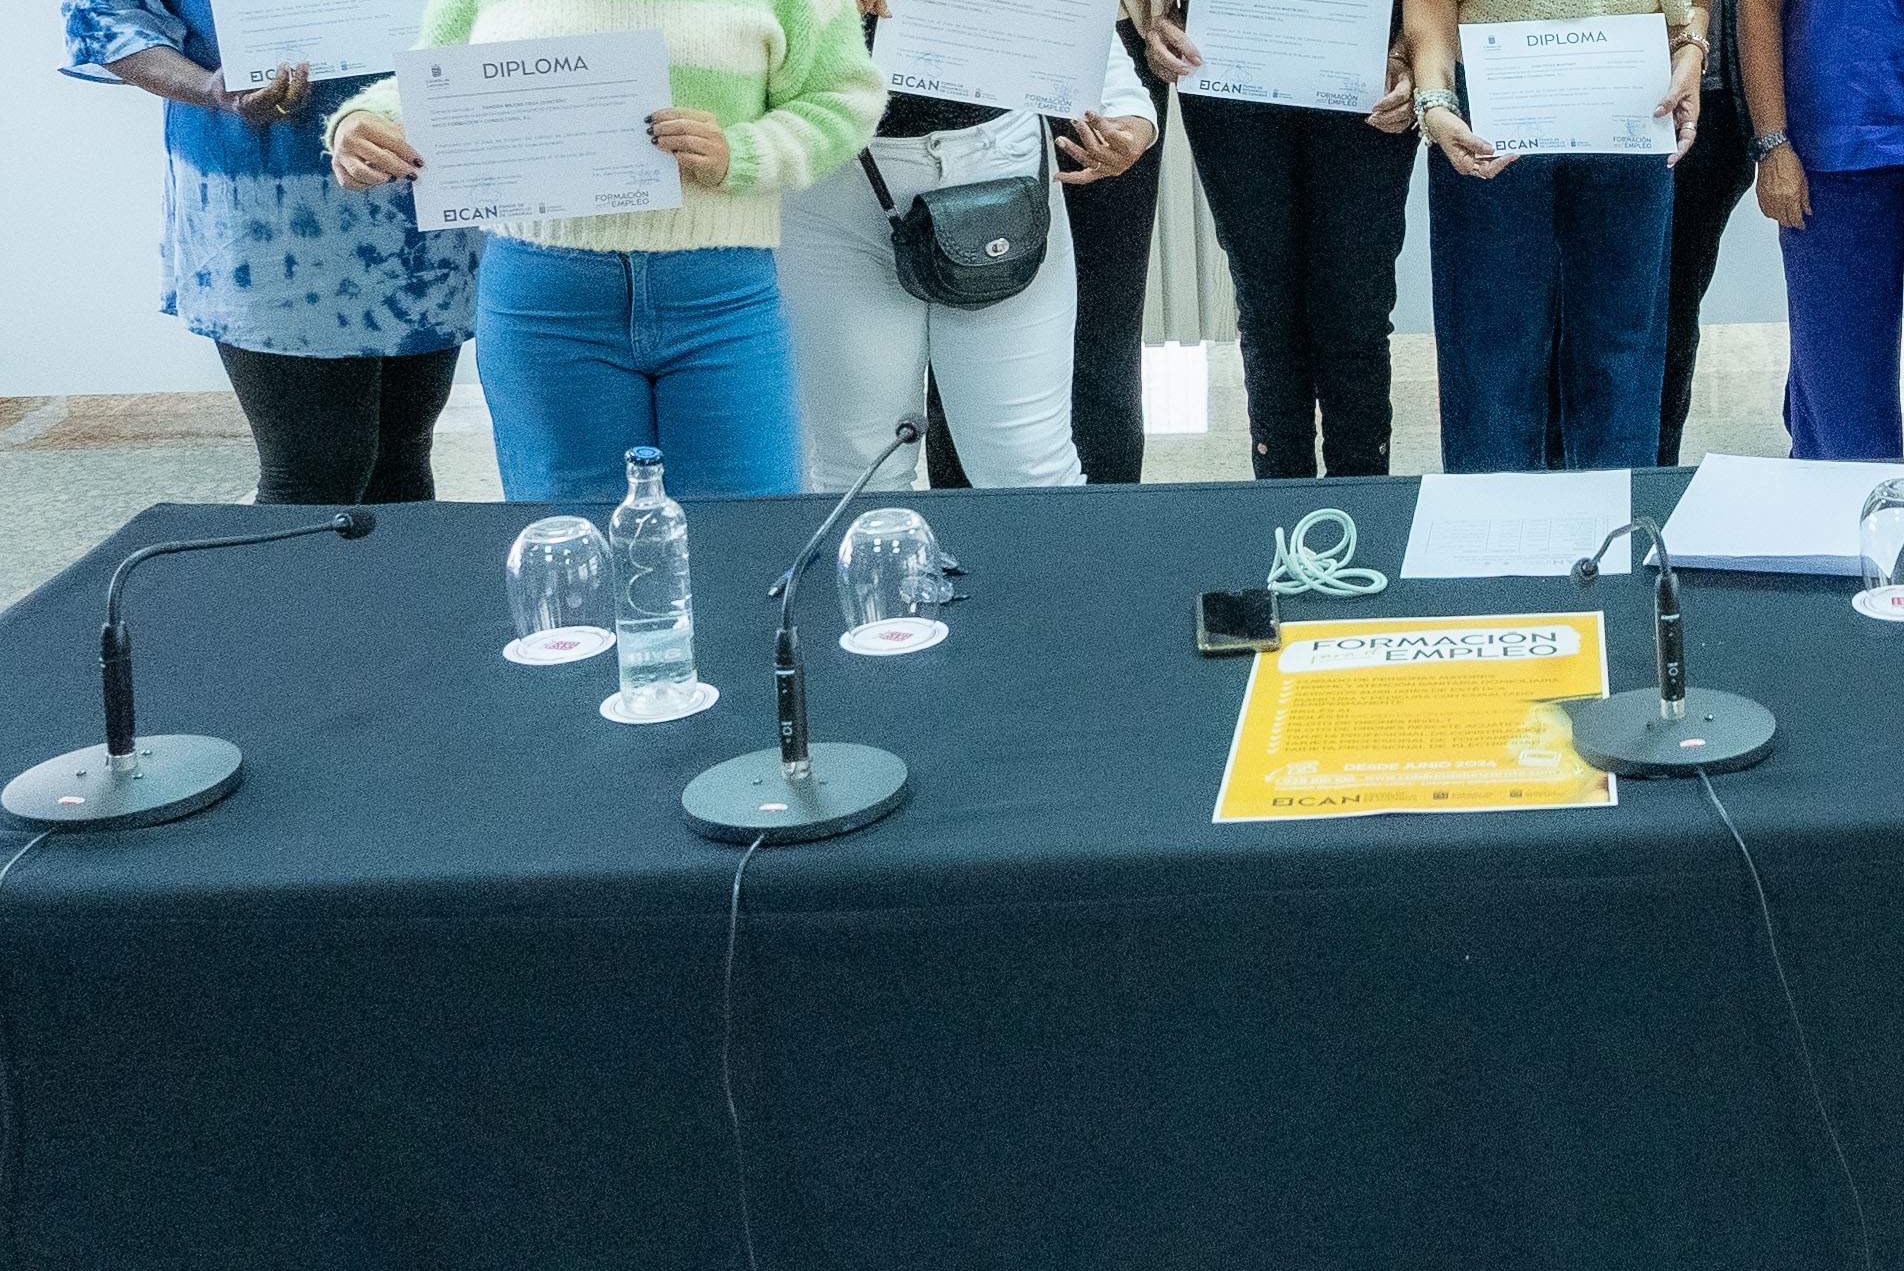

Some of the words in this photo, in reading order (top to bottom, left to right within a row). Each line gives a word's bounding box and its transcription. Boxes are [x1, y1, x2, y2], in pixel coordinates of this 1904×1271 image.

[1526, 30, 1608, 47] DIPLOMA
[482, 54, 590, 80] DIPLOMA
[1313, 631, 1557, 651] FORMACIÓN
[1385, 644, 1558, 661] EMPLEO
